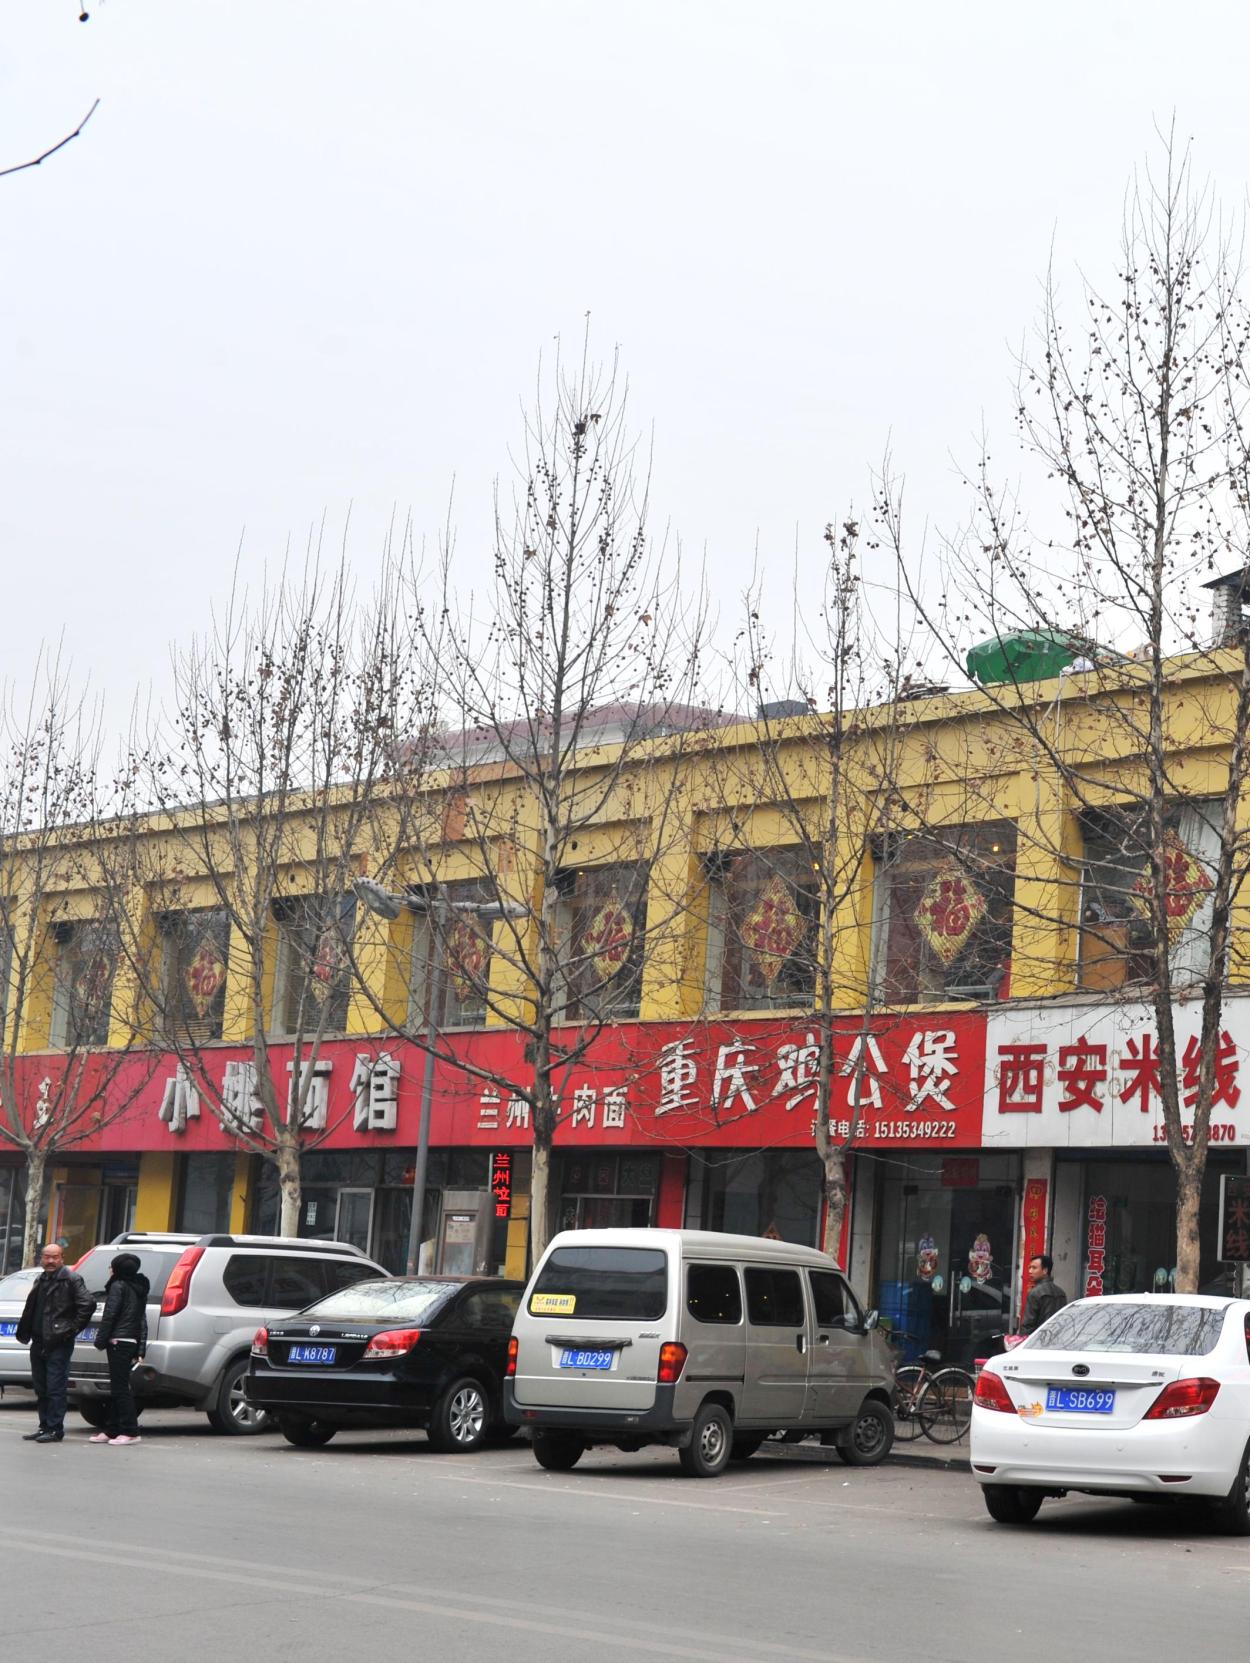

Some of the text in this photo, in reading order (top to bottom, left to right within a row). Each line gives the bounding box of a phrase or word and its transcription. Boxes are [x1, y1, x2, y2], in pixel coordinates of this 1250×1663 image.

[655, 1031, 959, 1118] 重庆鸡公煲
[998, 1030, 1241, 1113] 西安米线
[477, 1084, 628, 1129] 兰州肉面
[874, 1121, 956, 1138] 15135349222
